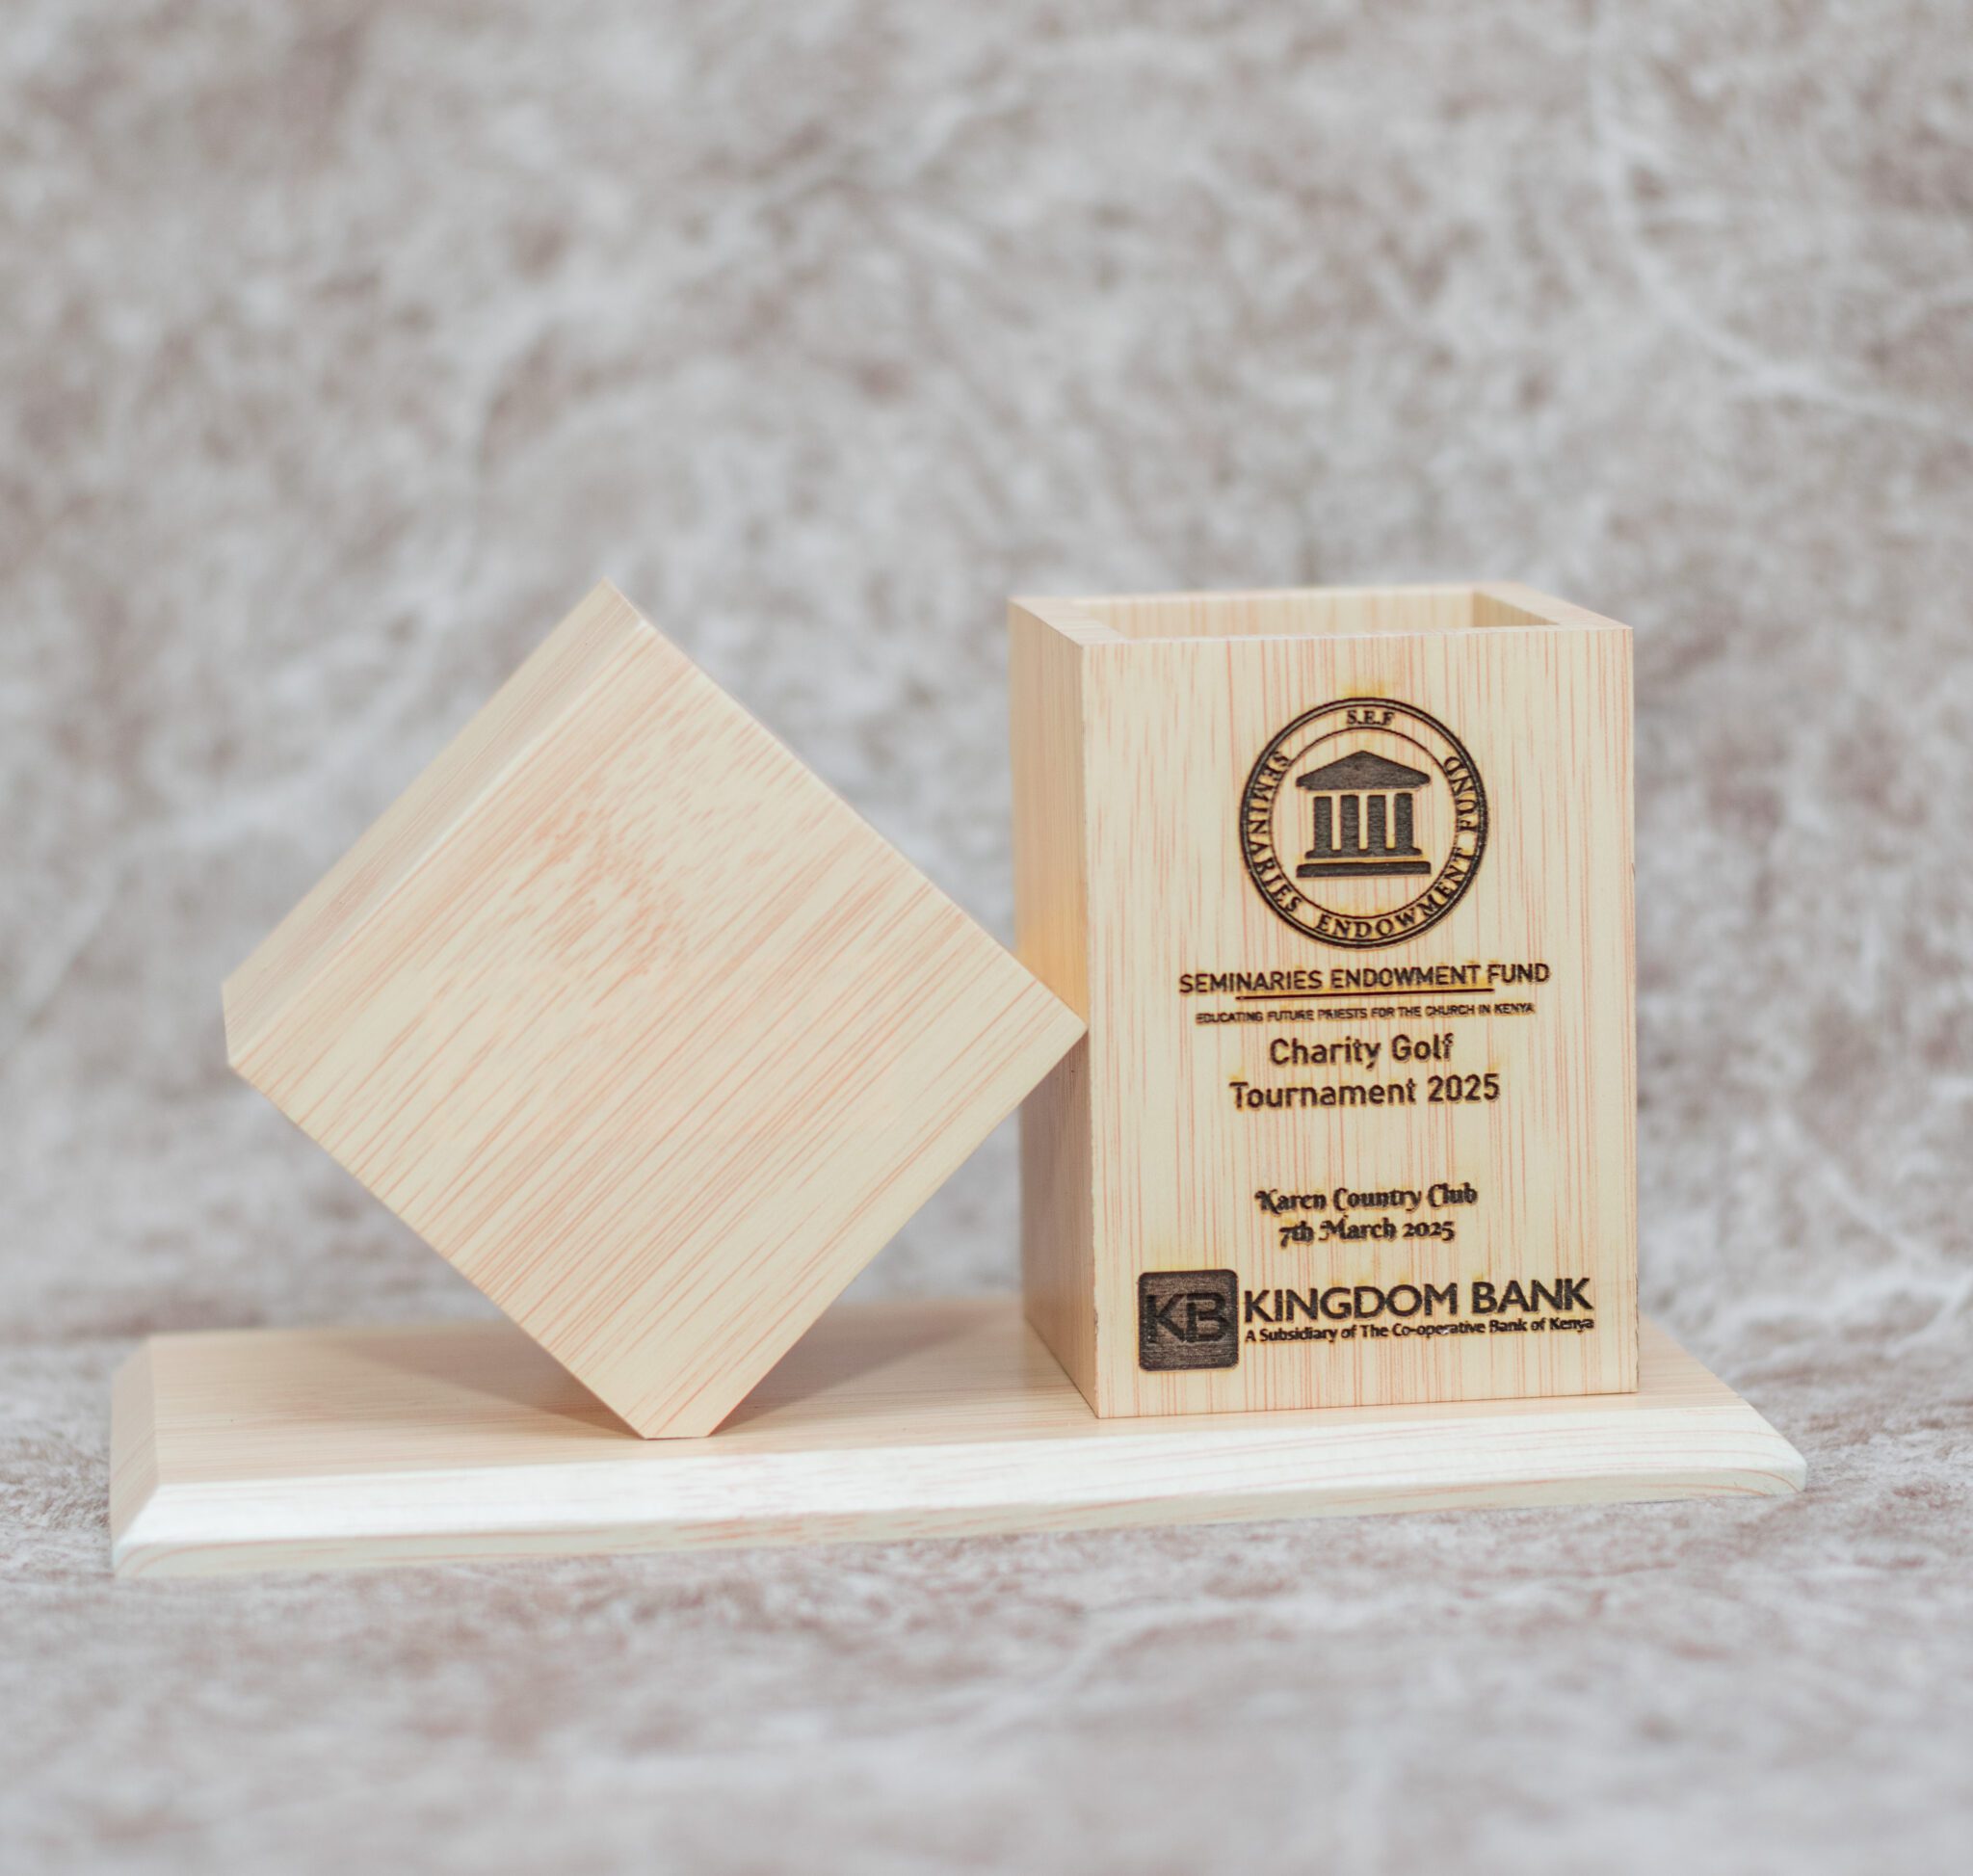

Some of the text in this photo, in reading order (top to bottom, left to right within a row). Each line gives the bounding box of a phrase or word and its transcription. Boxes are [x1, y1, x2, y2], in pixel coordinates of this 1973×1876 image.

[1248, 750, 1481, 938] SEMINARIES ENDOWMENT FUND
[1179, 963, 1550, 994] SEMINARIES ENDOWMENT FUND
[1196, 1002, 1535, 1024] EDUCATING FUTURE PRIESTS FOR THE CHURCH IN KENYA
[1270, 1033, 1455, 1070] Charity Golf
[1229, 1073, 1500, 1109] Tournament 2025
[1254, 1182, 1479, 1214] Karen Country Club
[1279, 1214, 1456, 1249] 7th March 2025
[1145, 1292, 1229, 1343] KB
[1244, 1277, 1594, 1324] KINGDOM BANK
[1246, 1316, 1595, 1343] A Subsidiary of The Co-operative Bank of Kenya
